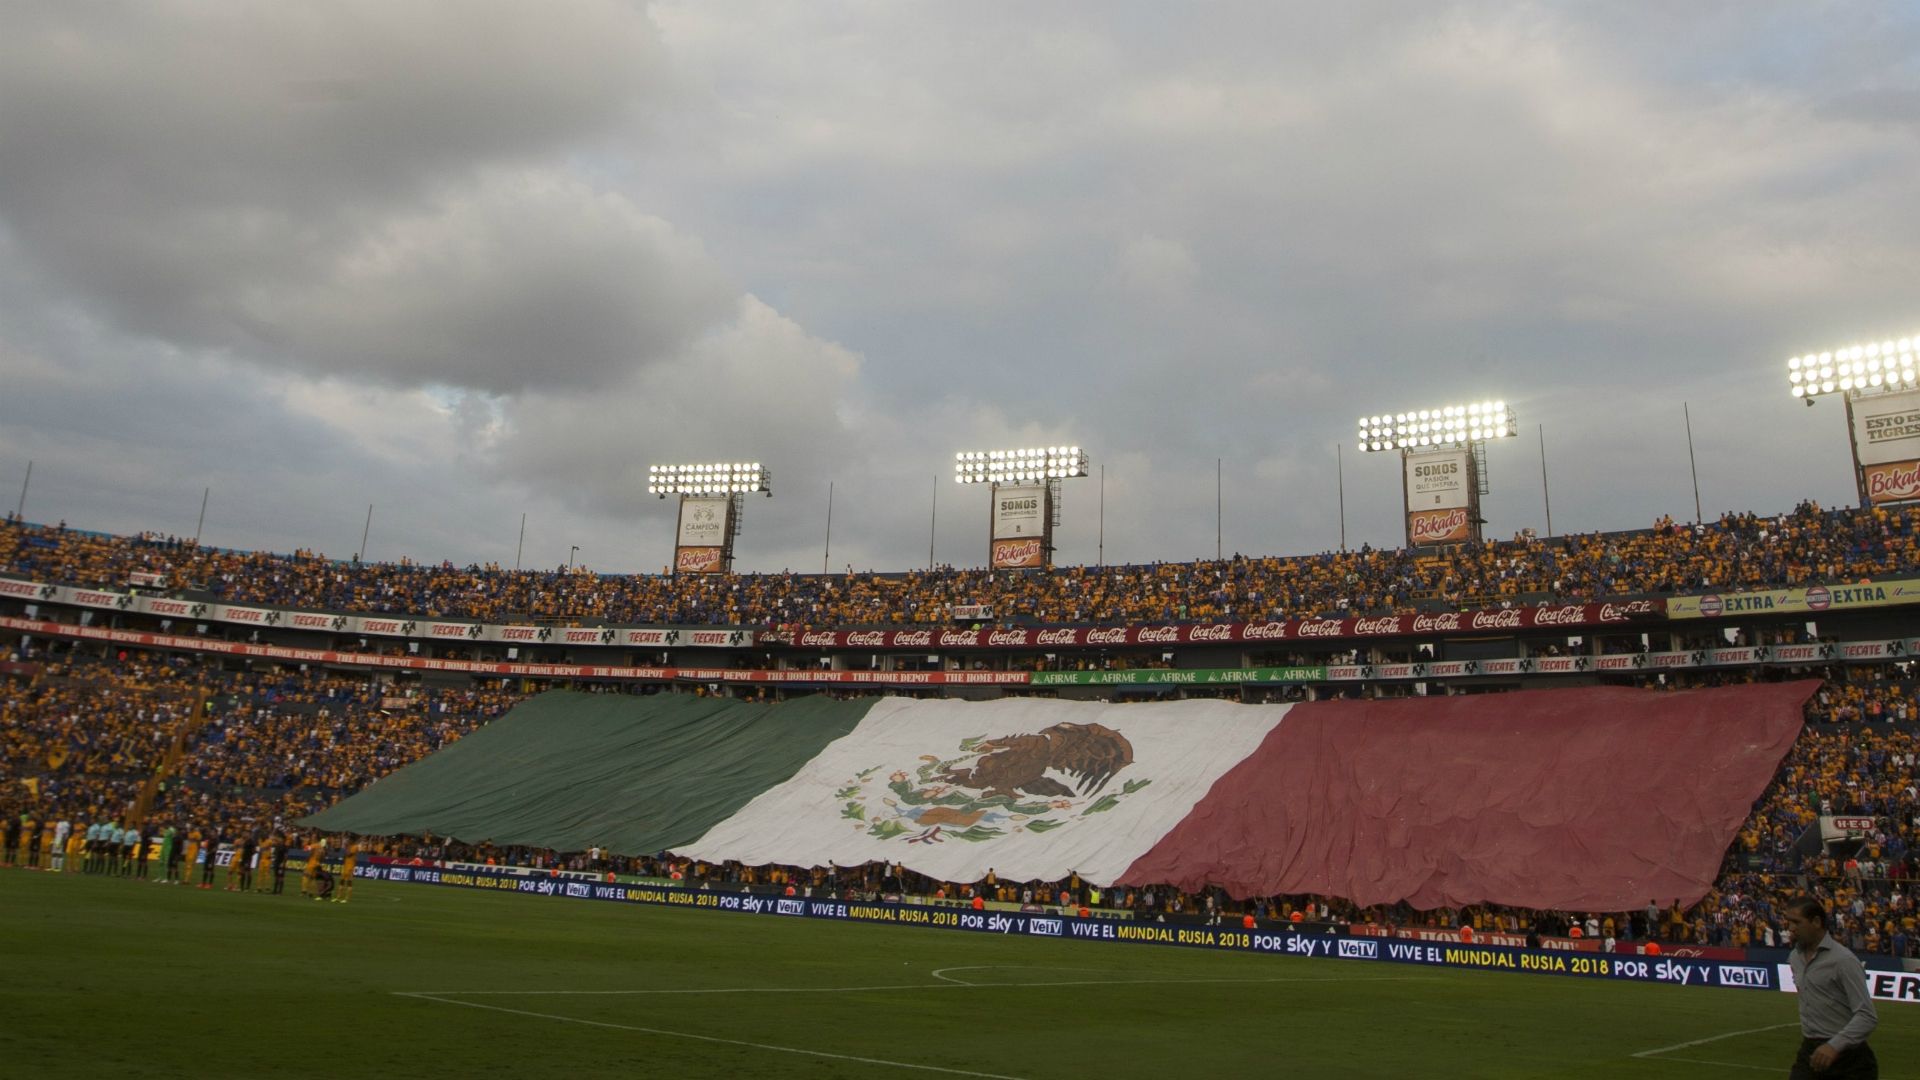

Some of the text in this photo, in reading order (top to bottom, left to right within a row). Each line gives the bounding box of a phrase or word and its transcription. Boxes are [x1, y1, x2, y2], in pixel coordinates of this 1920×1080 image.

[1866, 416, 1904, 429] ESTO
[1867, 424, 1920, 440] TIGRES
[1415, 463, 1458, 477] SOMOS
[1001, 500, 1038, 511] SOMOS
[1413, 510, 1467, 537] Bokados
[995, 541, 1040, 562] Bokados
[679, 549, 720, 568] Bokados
[75, 591, 114, 606] TECATE
[1834, 587, 1886, 604] EXTRA
[150, 600, 188, 614] TECATE
[1726, 596, 1774, 612] EXTRA
[226, 608, 262, 622] TECATE
[294, 614, 330, 627] TECATE
[1472, 608, 1523, 628] Coca-Cola
[1534, 605, 1586, 626] Coca-Cola
[364, 621, 399, 633] TECATE
[1298, 618, 1344, 637] Coca-Cola
[1354, 617, 1402, 635] Coca-Cola
[1413, 612, 1462, 632] Coca-Cola
[432, 624, 467, 636] TECATE
[502, 628, 536, 640] TECATE
[566, 631, 599, 642] TECATE
[1087, 628, 1128, 644] Coca-Cola
[1138, 626, 1180, 642] Coca-Cola
[1190, 624, 1233, 641] Coca-Cola
[1243, 622, 1287, 640] Coca-Cola
[629, 632, 663, 643] TECATE
[694, 632, 728, 644] TECATE
[802, 631, 838, 646] Coca-Cola
[847, 631, 886, 646] Coca-Cola
[894, 631, 933, 646] Coca-Cola
[940, 631, 980, 646] Coca-Cola
[988, 630, 1028, 646] Coca-Cola
[1036, 630, 1078, 645] Coca-Cola
[1715, 650, 1750, 662] TECATE
[1778, 648, 1814, 658] TECATE
[1844, 644, 1882, 656] TECATE
[424, 660, 498, 672] THE HOME DEPOT
[1540, 660, 1572, 670] TECATE
[1597, 658, 1629, 668] TECATE
[1654, 654, 1688, 666] TECATE
[510, 664, 583, 676] THE HOME DEPOT
[593, 667, 664, 678] THE HOME DEPOT
[1329, 668, 1358, 678] TECATE
[1380, 666, 1409, 676] TECATE
[1432, 664, 1462, 674] TECATE
[1484, 662, 1516, 672] TECATE
[724, 670, 752, 680] DEPOT
[766, 672, 842, 681] THE HOME DEPOT
[853, 673, 929, 682] THE HOME DEPOT
[944, 673, 1027, 683] THE HOME DEPOT
[1044, 674, 1078, 683] AFIRME
[1102, 672, 1137, 683] AFIRME
[1160, 672, 1196, 682] AFIRME
[1220, 671, 1258, 682] AFIRME
[1282, 669, 1321, 680] AFIRME
[364, 866, 382, 880] sky
[382, 868, 388, 878] Y
[414, 870, 590, 896] VIVE EL MUNDIAL RUSIA 2018 POR sky Y VeTV
[596, 886, 804, 914] VIVE EL MUNDIAL RUSIA 2018 POR sky Y VeTV
[812, 902, 1061, 935] VIVE EL MUNDIAL RUSIA 2018 POR sky Y VeTV
[1072, 922, 1376, 958] VIVE EL MUNDIAL RUSIA 2018 POR sky Y VeTV
[1389, 944, 1768, 986] VIVE EL MUNDIAL RUSIA 2018 POR sky Y VeTV
